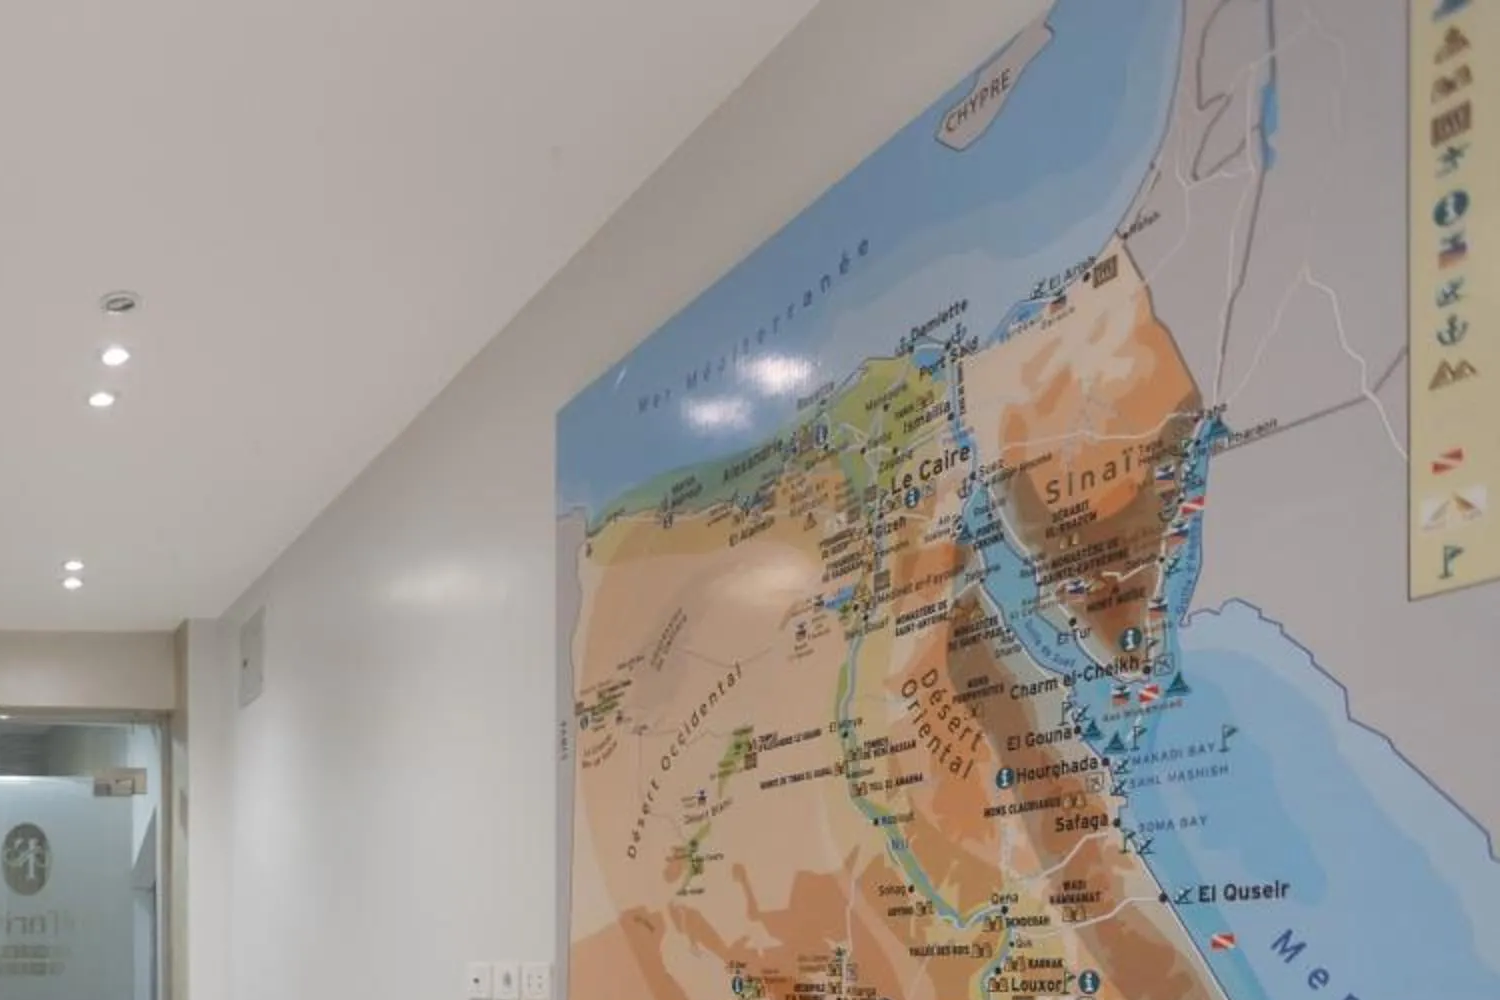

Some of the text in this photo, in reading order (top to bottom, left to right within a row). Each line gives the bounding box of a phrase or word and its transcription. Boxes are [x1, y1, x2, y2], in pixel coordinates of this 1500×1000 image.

[944, 68, 1013, 134] CHYPRE
[891, 472, 912, 494] Le
[919, 446, 970, 480] Caire
[1010, 655, 1142, 699] Charm el-Cheikh
[659, 659, 743, 772] Occidental
[901, 677, 976, 781] Oriental
[921, 667, 984, 751] Désert
[1007, 727, 1072, 751] El Gouna
[1016, 757, 1098, 784] Hourghada
[1054, 812, 1109, 832] Safaga
[1199, 879, 1291, 902] El Quseir
[1011, 976, 1063, 992] Louxor
